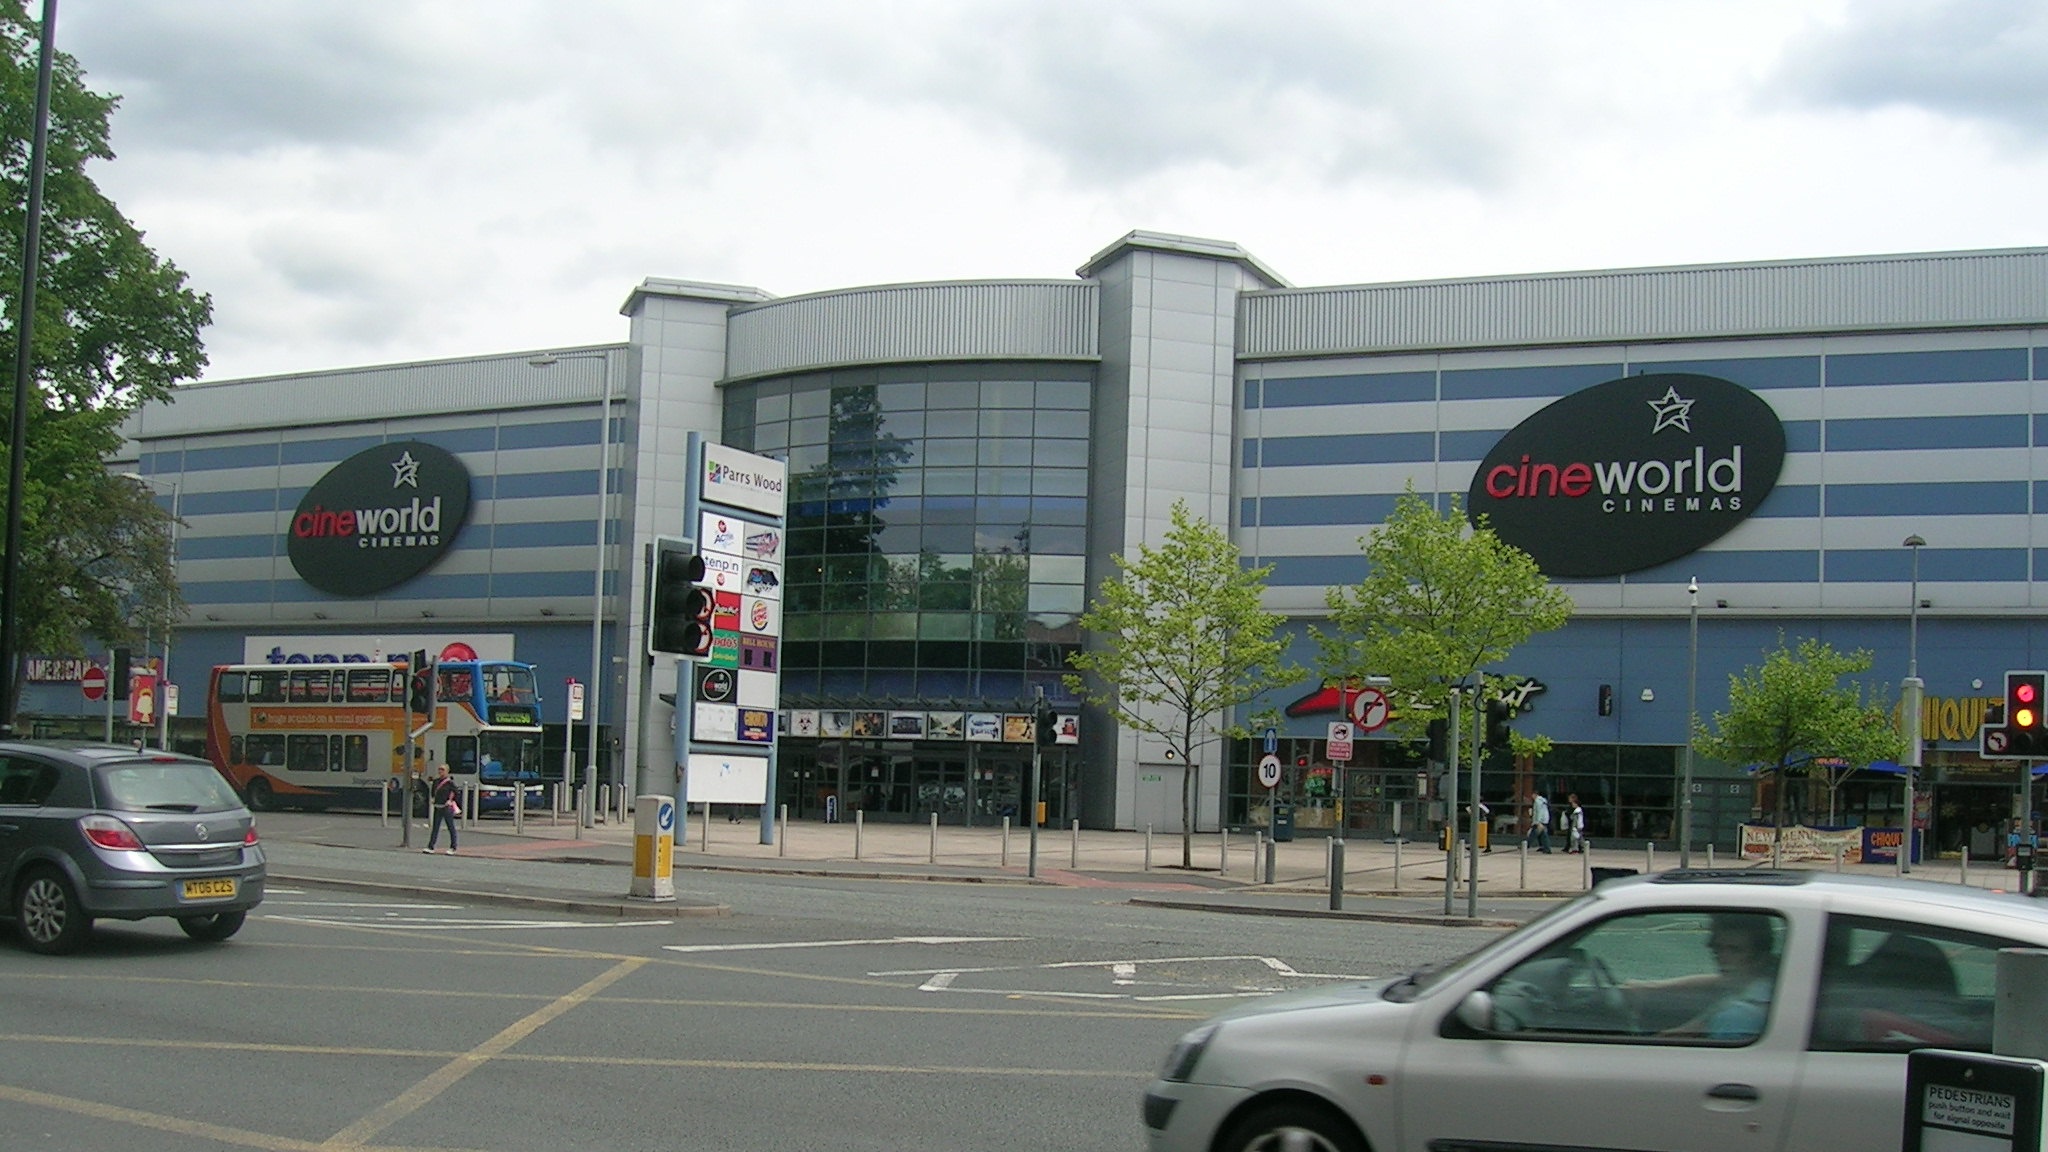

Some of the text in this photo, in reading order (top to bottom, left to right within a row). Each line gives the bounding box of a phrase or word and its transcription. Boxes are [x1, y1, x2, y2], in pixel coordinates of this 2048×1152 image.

[722, 465, 751, 485] Parrs
[754, 473, 782, 492] Wood
[1485, 445, 1742, 499] cineworld
[1602, 497, 1742, 513] CINEMAS
[294, 496, 441, 538] cineworld
[358, 535, 440, 548] CINEMAS
[704, 556, 739, 572] tenpn
[1264, 763, 1276, 779] 10
[1929, 1087, 2011, 1108] PEDESTRIANS
[1928, 1101, 2011, 1119] push button and wait
[1933, 1111, 2005, 1130] for signal opposite
